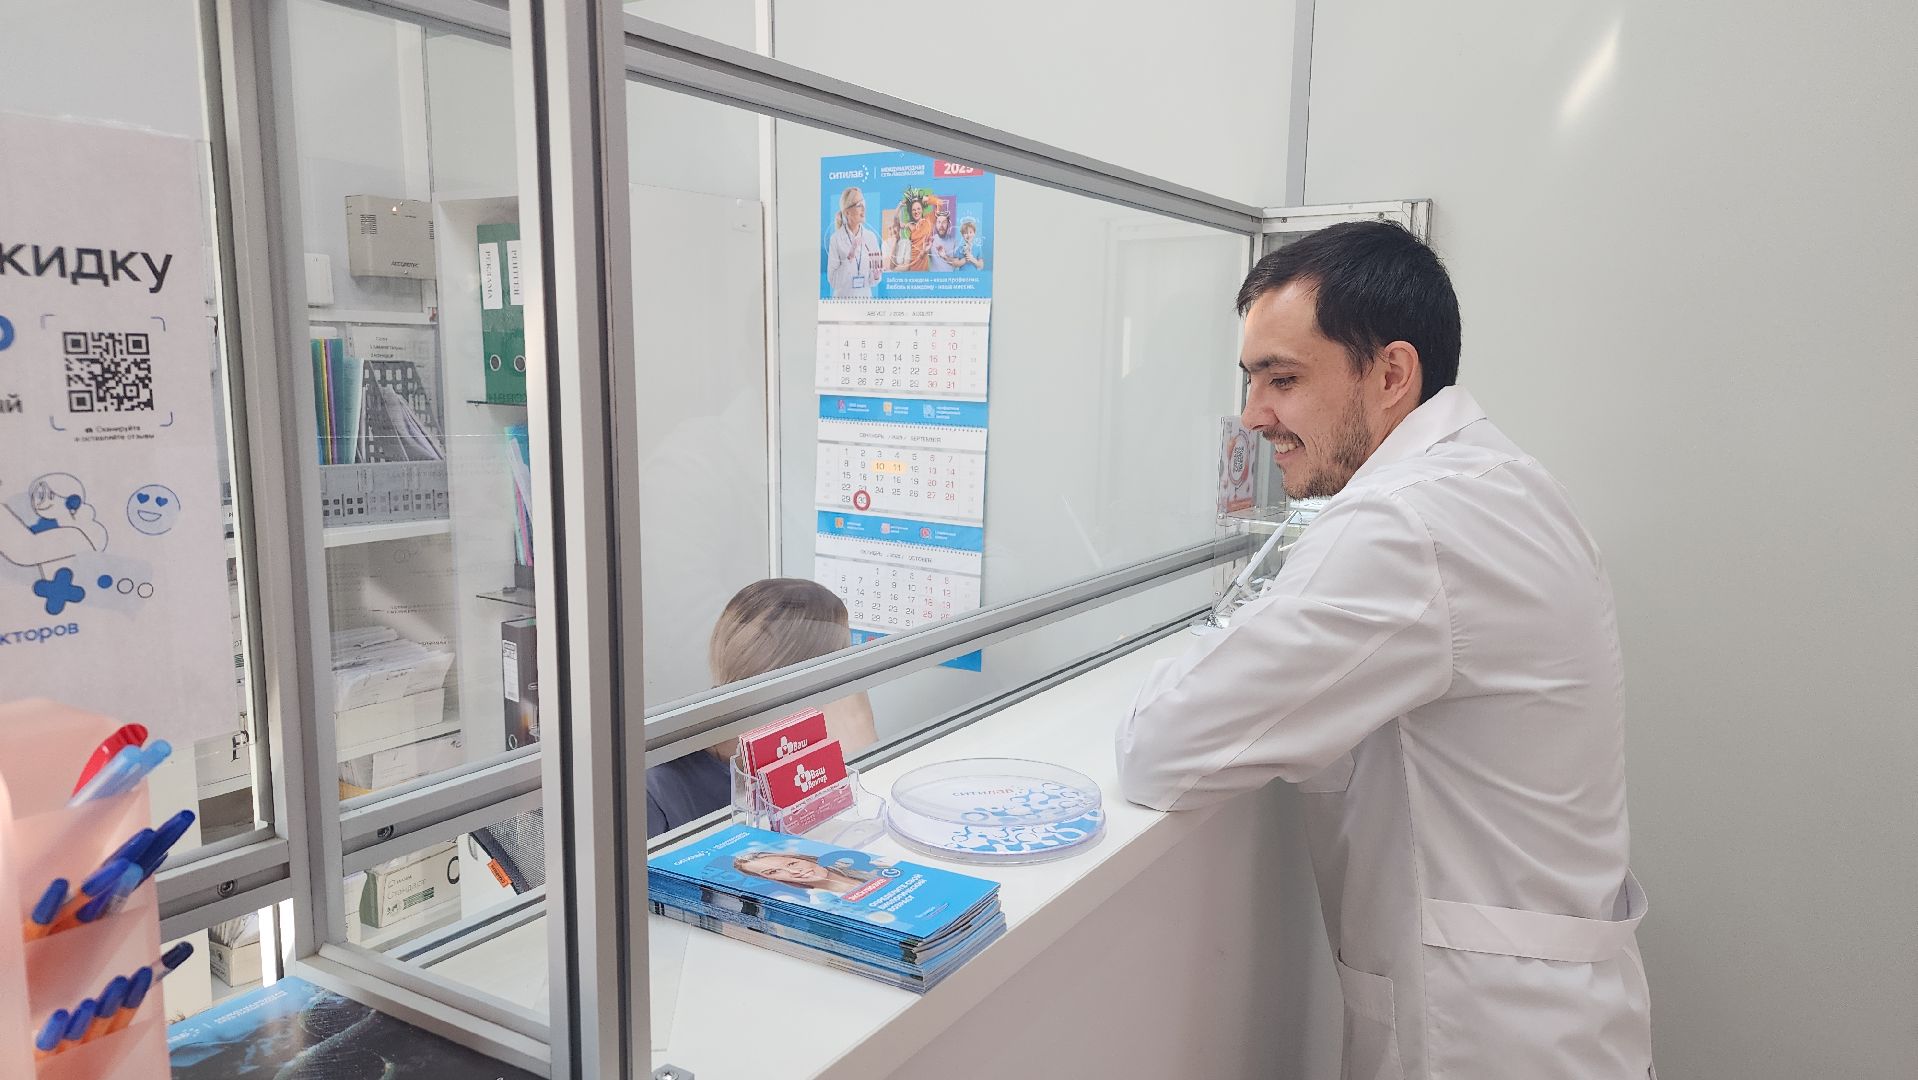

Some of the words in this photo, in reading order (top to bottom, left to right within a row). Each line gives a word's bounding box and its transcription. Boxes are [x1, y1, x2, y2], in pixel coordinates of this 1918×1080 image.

[0, 242, 173, 294] кидку
[0, 623, 79, 645] кторов
[810, 766, 826, 779] Ваш
